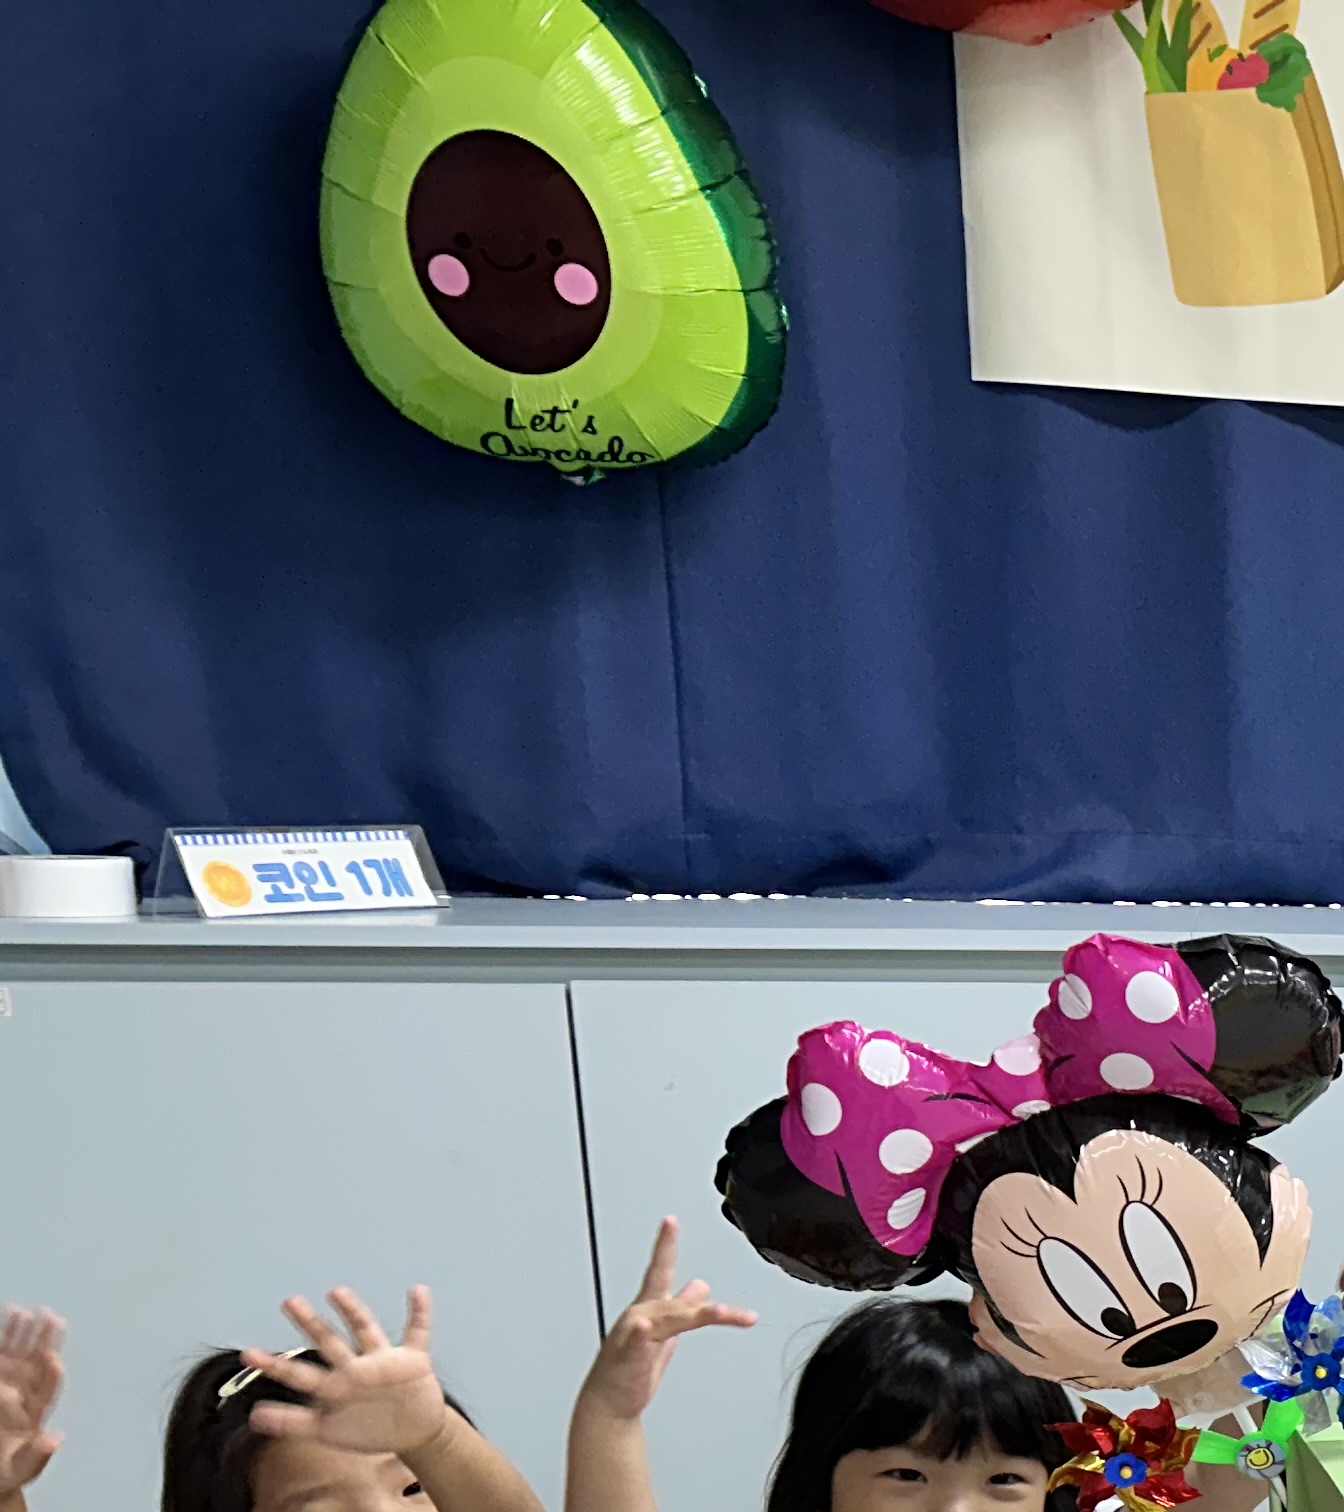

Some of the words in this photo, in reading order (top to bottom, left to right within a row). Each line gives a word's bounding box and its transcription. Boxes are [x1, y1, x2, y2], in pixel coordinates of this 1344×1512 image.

[505, 398, 598, 434] Let's
[480, 431, 656, 465] Avocado
[252, 860, 345, 903] 코인
[345, 858, 414, 897] 1개
